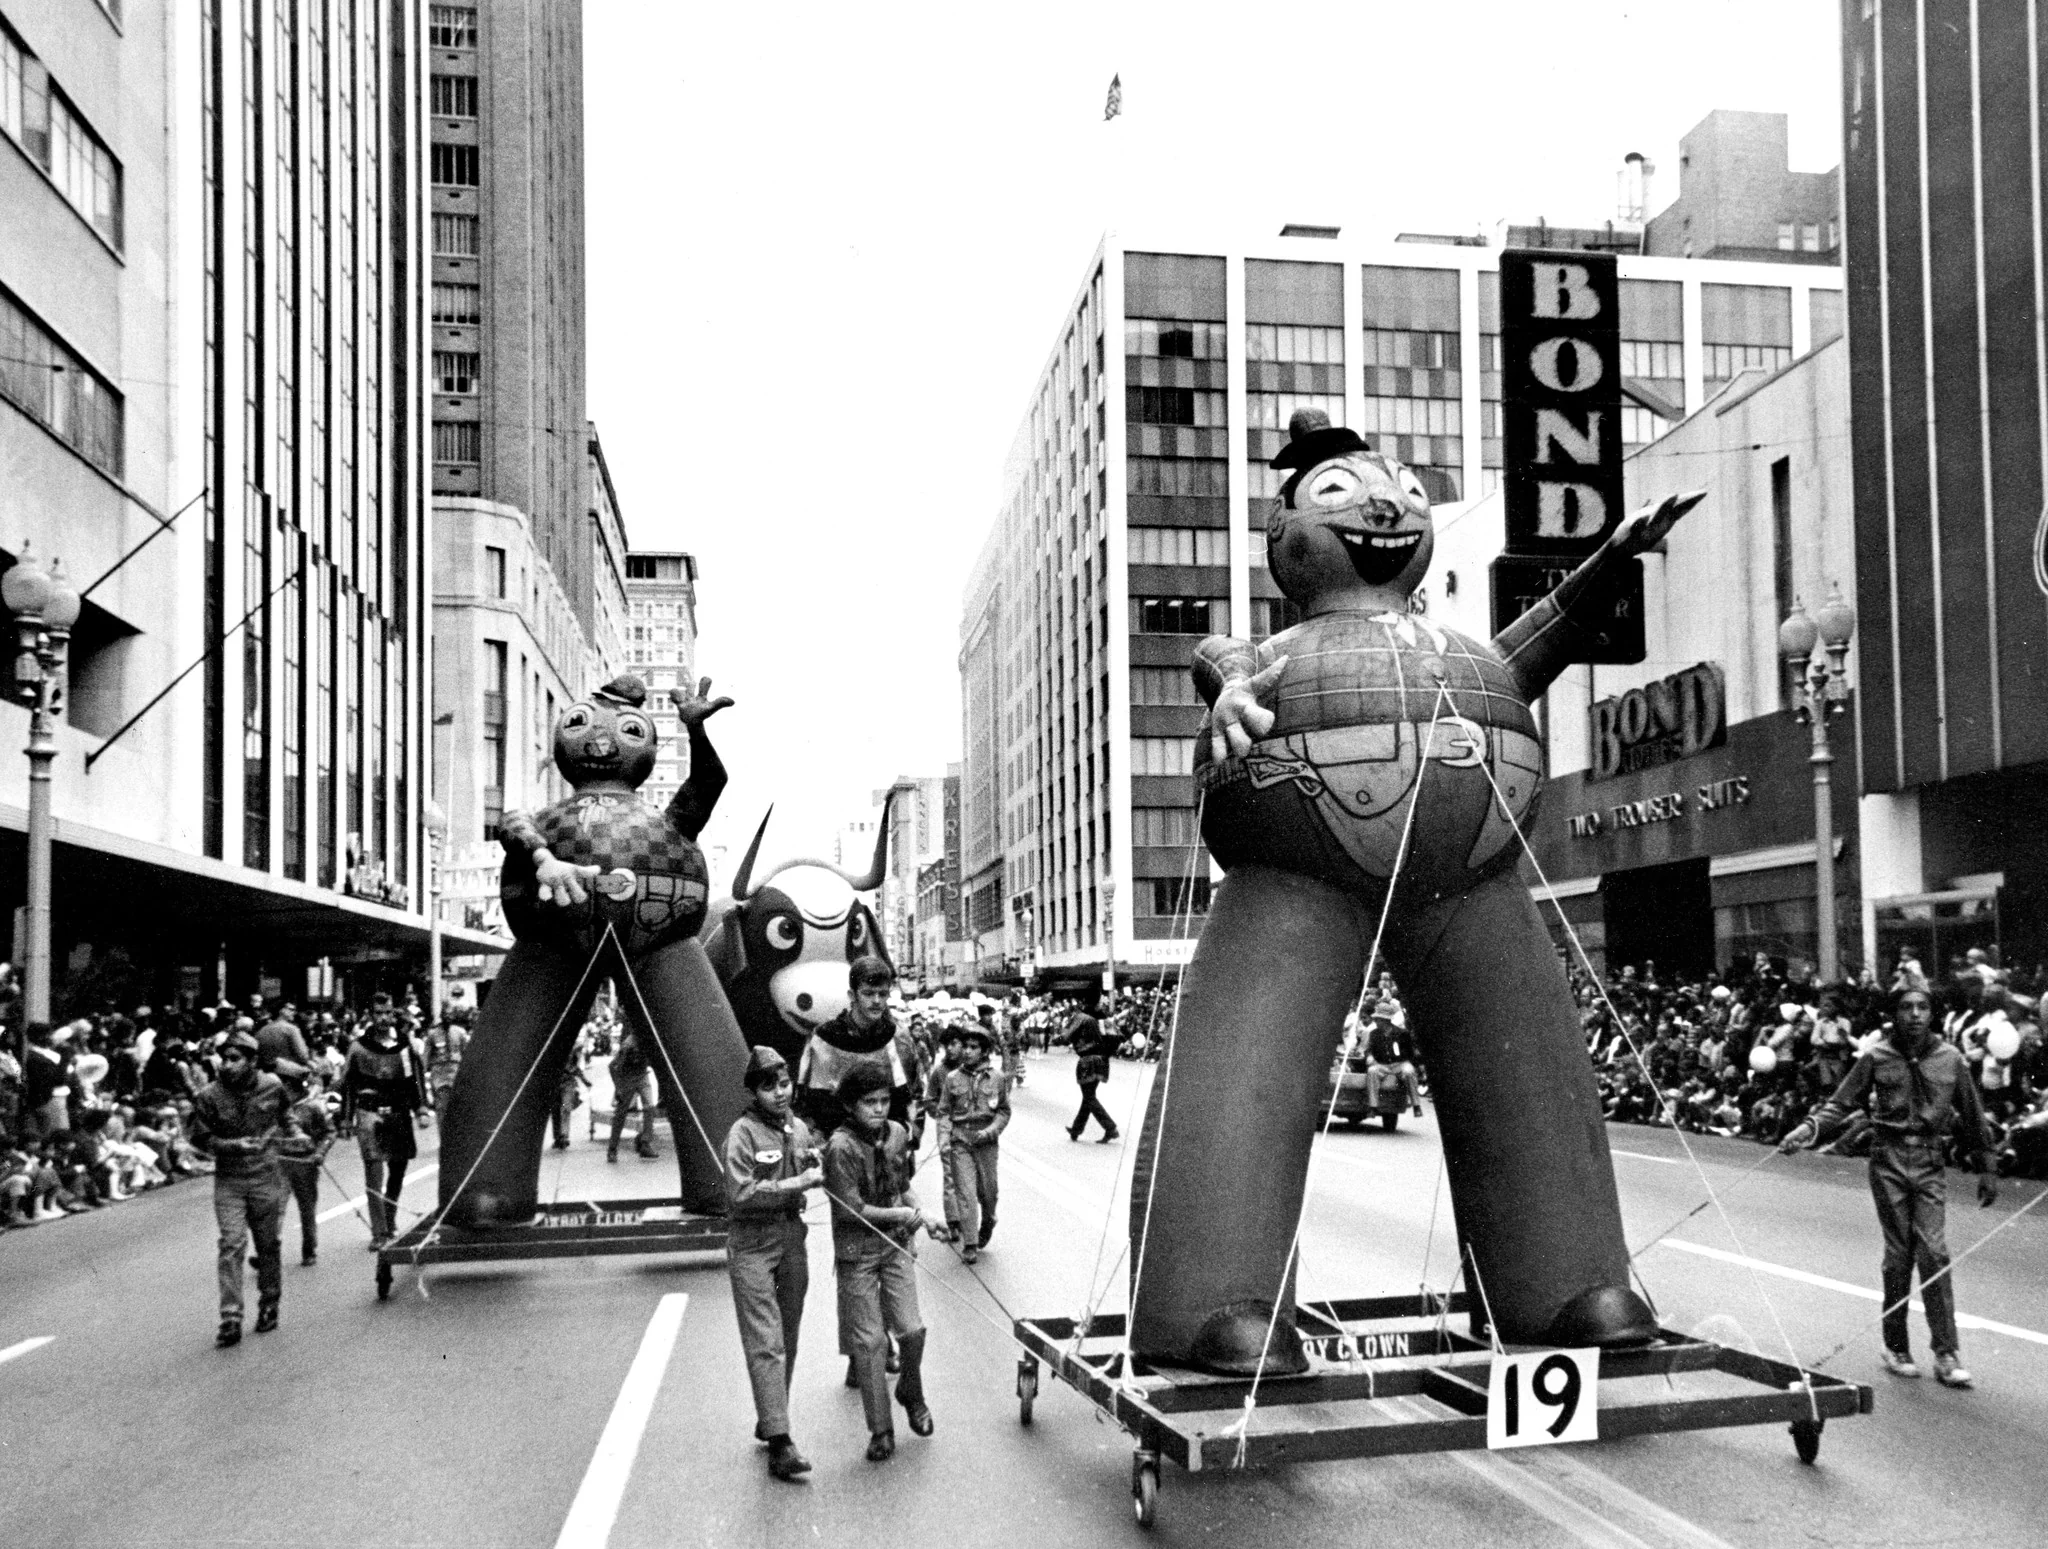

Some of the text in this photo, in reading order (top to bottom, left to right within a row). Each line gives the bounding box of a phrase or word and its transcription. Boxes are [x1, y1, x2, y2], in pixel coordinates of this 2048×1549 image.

[1530, 262, 1606, 538] BOND
[1588, 661, 1727, 781] BOND
[1566, 776, 1749, 835] TWO TROUSER SUITS
[945, 786, 959, 931] KRESS
[1337, 1333, 1410, 1362] CLOWN
[1505, 1353, 1582, 1438] 19
